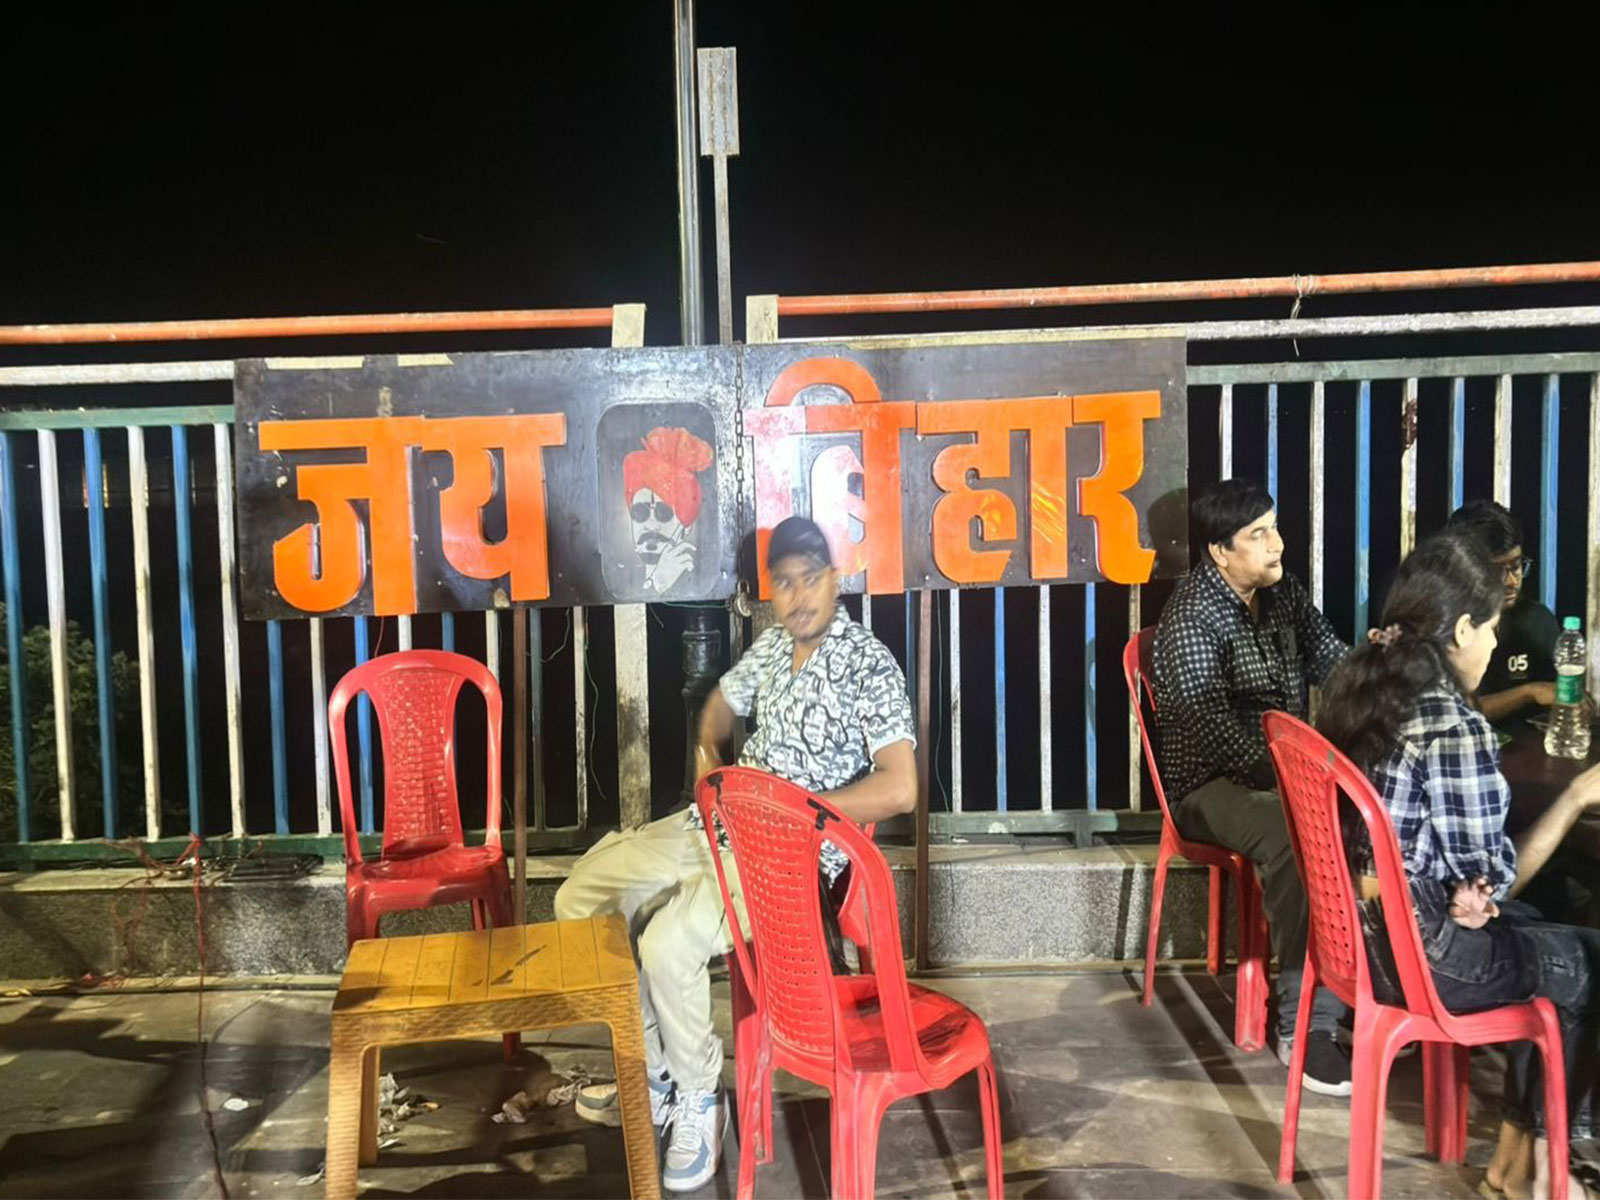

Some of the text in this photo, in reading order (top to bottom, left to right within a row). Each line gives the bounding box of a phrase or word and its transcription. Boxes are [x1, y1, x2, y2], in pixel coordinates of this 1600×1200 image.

[258, 356, 1162, 615] जय बिहार
[1507, 653, 1529, 671] 05
